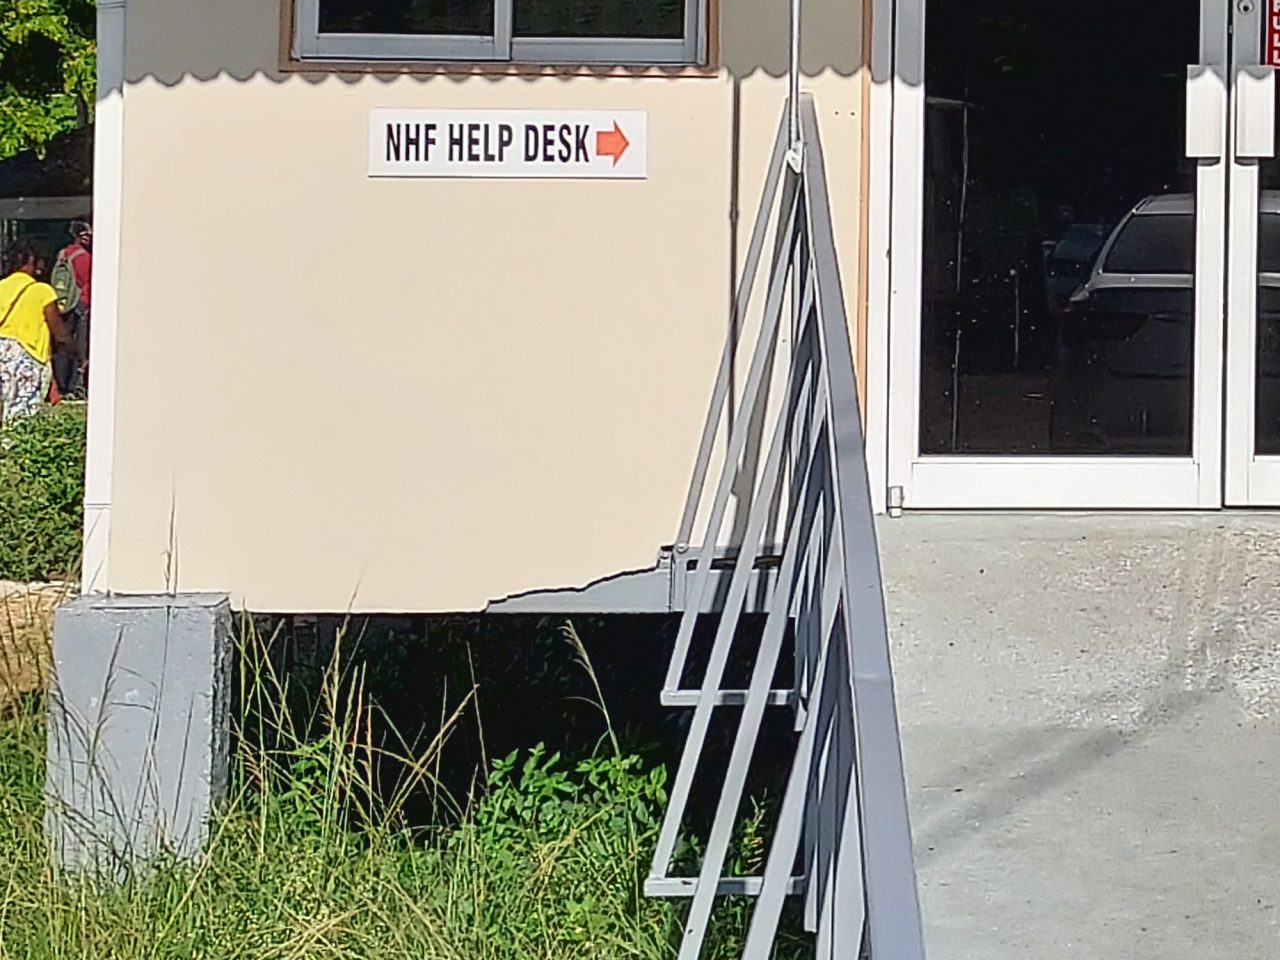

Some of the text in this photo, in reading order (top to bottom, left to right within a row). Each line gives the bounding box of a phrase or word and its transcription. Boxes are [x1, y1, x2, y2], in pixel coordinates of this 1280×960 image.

[386, 123, 590, 163] NHF HELP DESK
